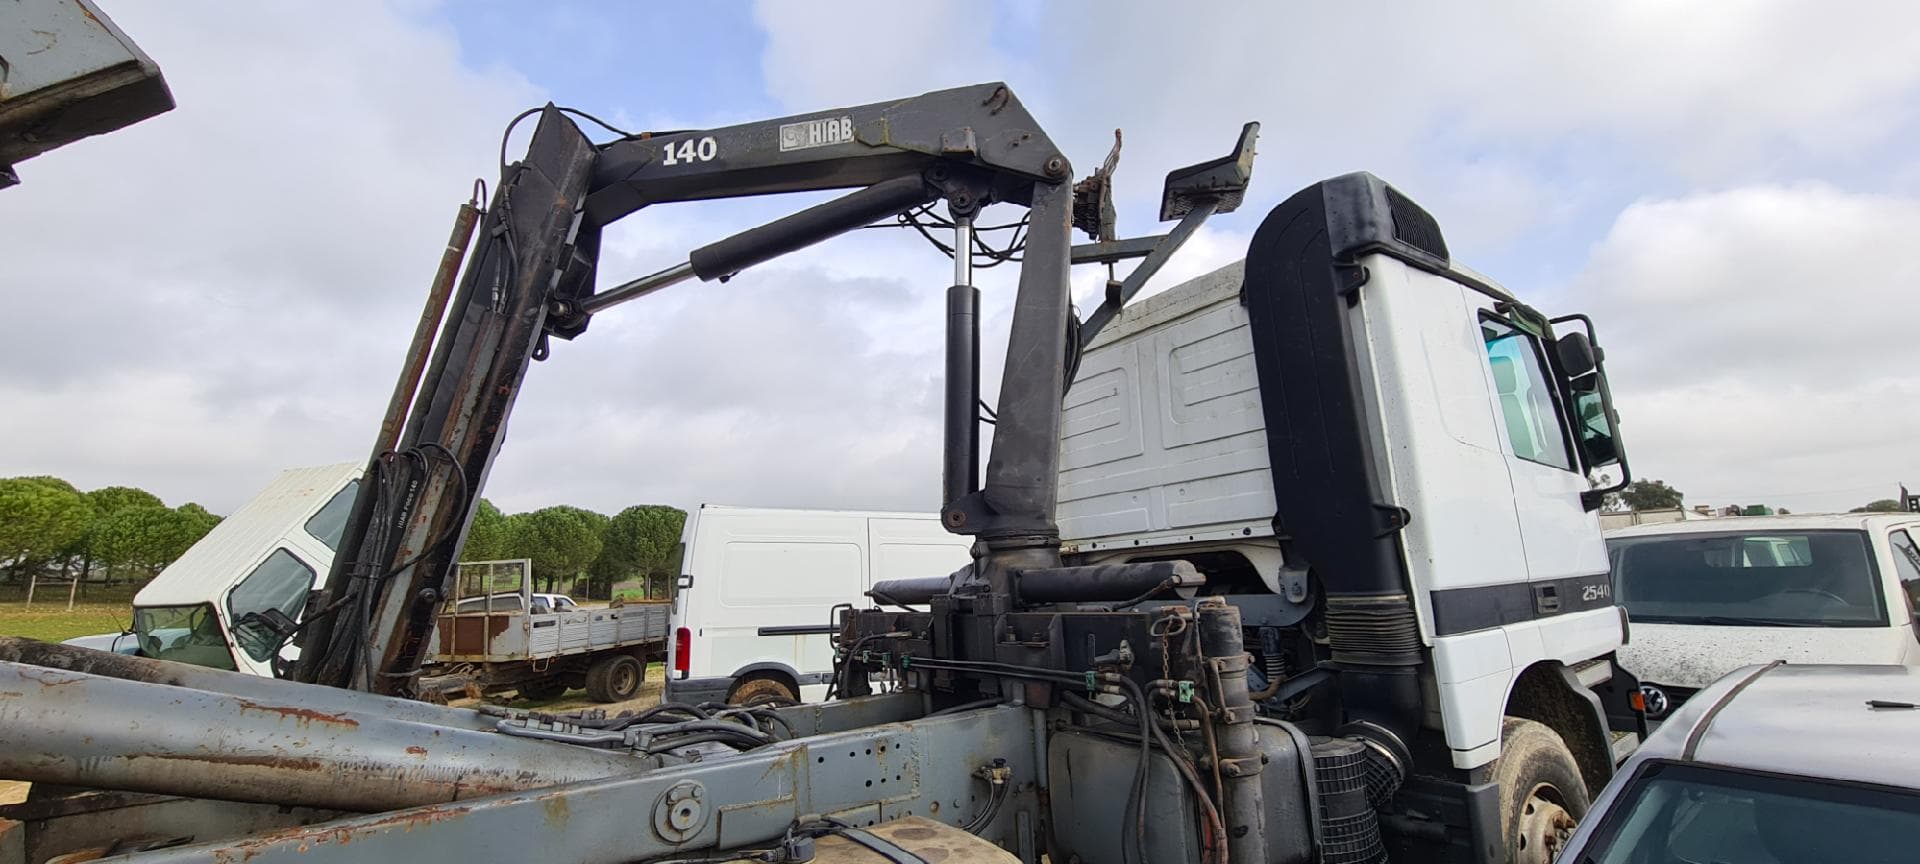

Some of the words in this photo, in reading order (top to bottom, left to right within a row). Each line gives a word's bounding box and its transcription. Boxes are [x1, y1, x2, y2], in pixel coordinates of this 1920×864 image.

[808, 116, 852, 144] HIAB
[663, 137, 717, 166] 140
[1582, 584, 1610, 601] 2540
